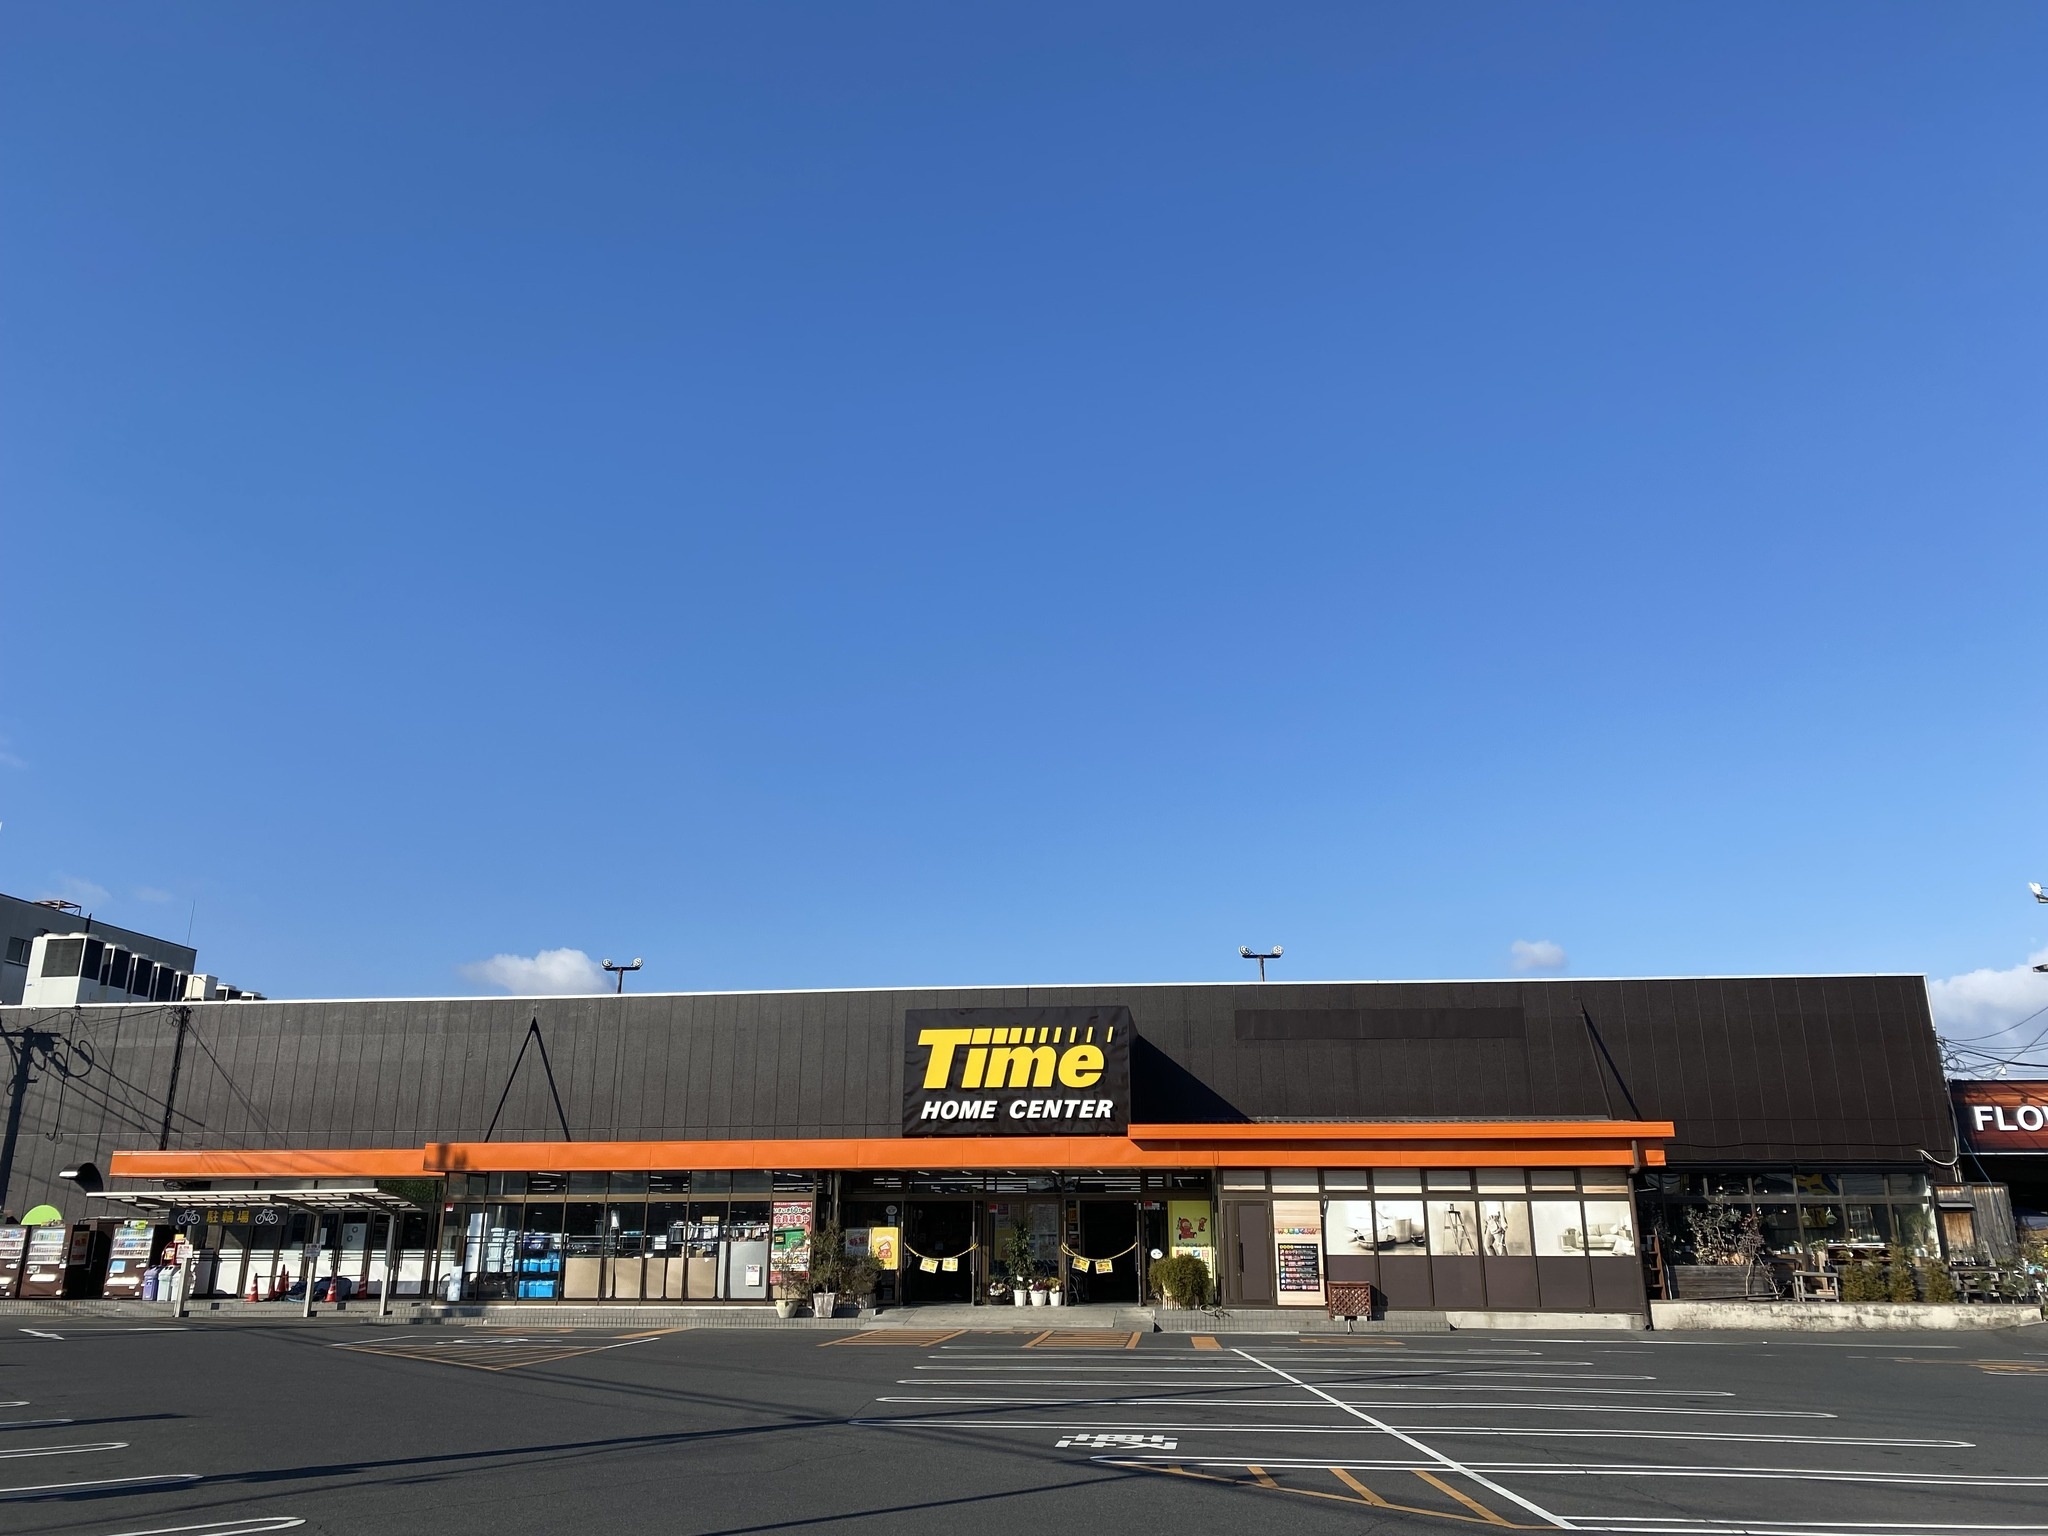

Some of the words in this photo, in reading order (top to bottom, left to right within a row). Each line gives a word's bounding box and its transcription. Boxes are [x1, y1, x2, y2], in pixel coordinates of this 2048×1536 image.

[918, 1027, 1107, 1089] Time
[921, 1100, 998, 1120] HOME
[1009, 1099, 1114, 1119] CENTER
[1973, 1105, 2048, 1131] FLO
[206, 1210, 250, 1224] 駐輪場
[1055, 1433, 1179, 1450] 軽
